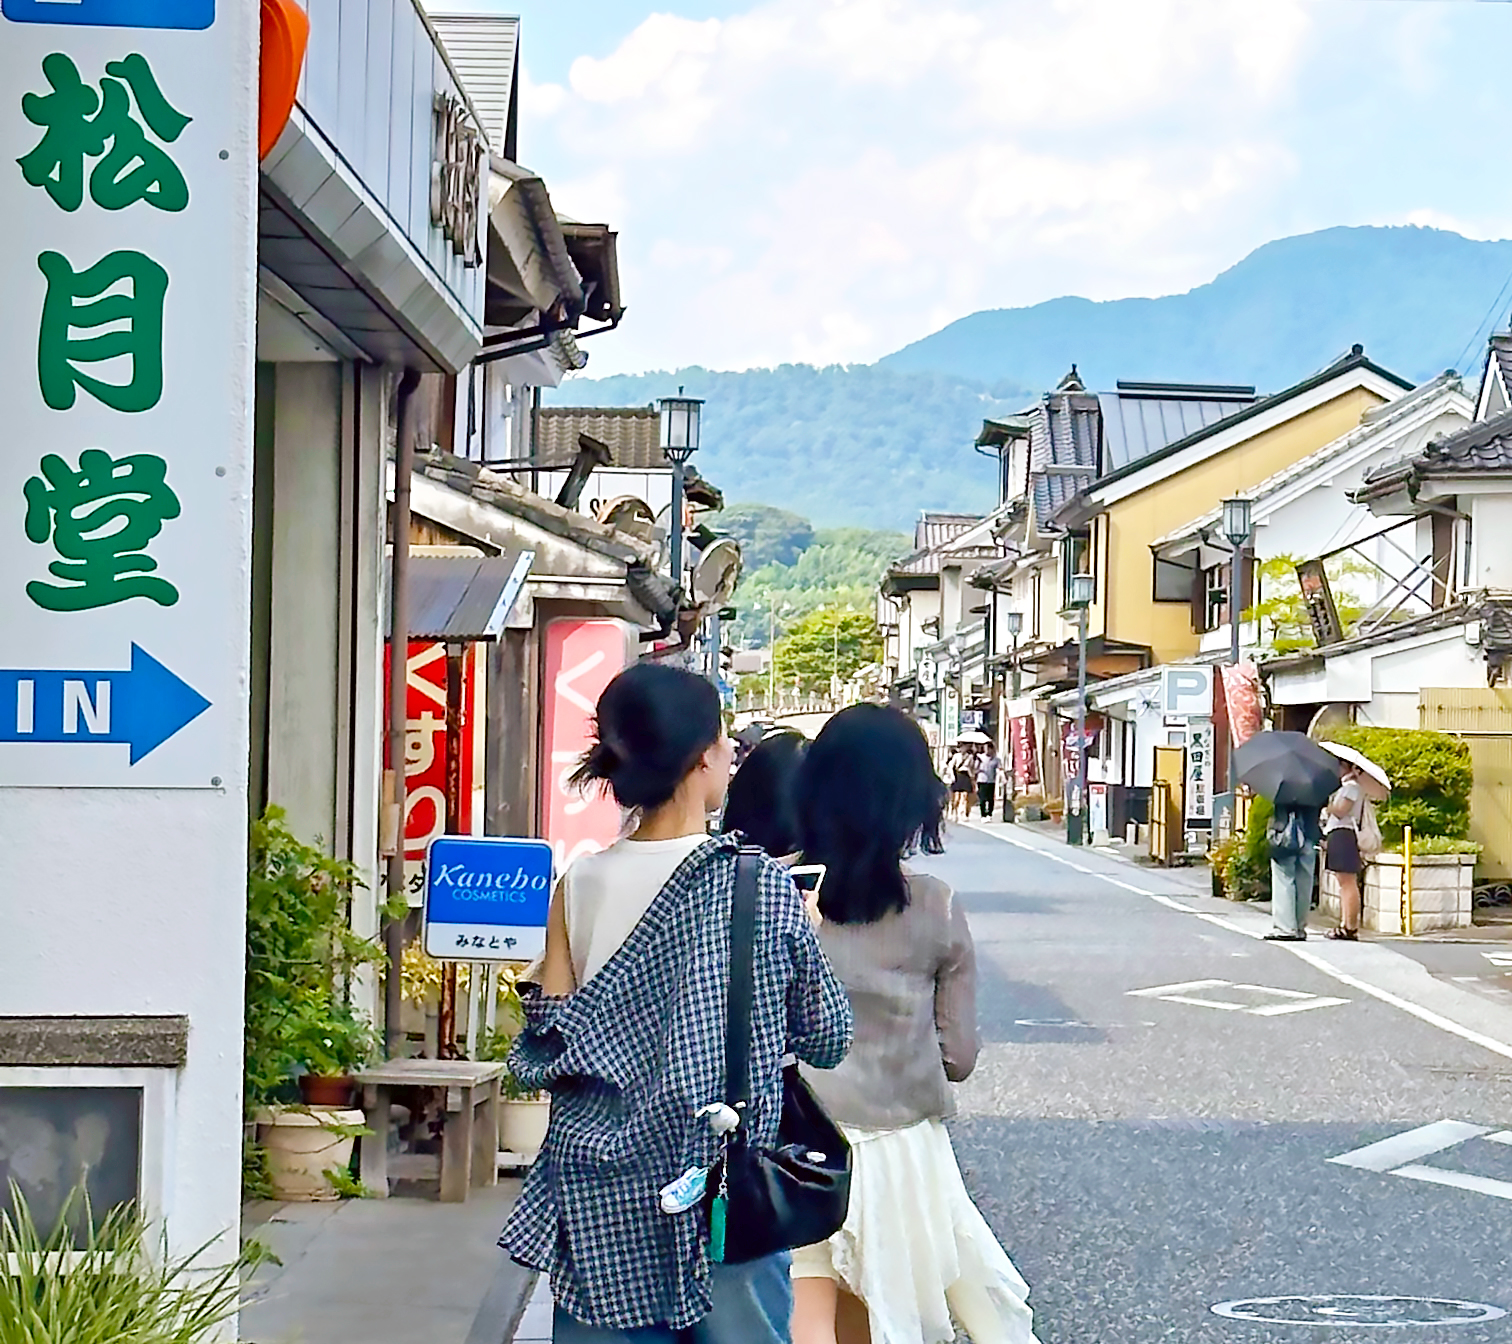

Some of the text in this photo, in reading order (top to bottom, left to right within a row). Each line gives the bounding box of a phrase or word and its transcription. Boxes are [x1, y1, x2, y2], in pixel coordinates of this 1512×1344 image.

[16, 52, 194, 612] 松月堂
[16, 679, 112, 734] IN
[1167, 670, 1208, 711] P
[433, 863, 548, 891] Kanebo
[452, 888, 528, 904] COSMETICS
[455, 933, 518, 950] みなとや
